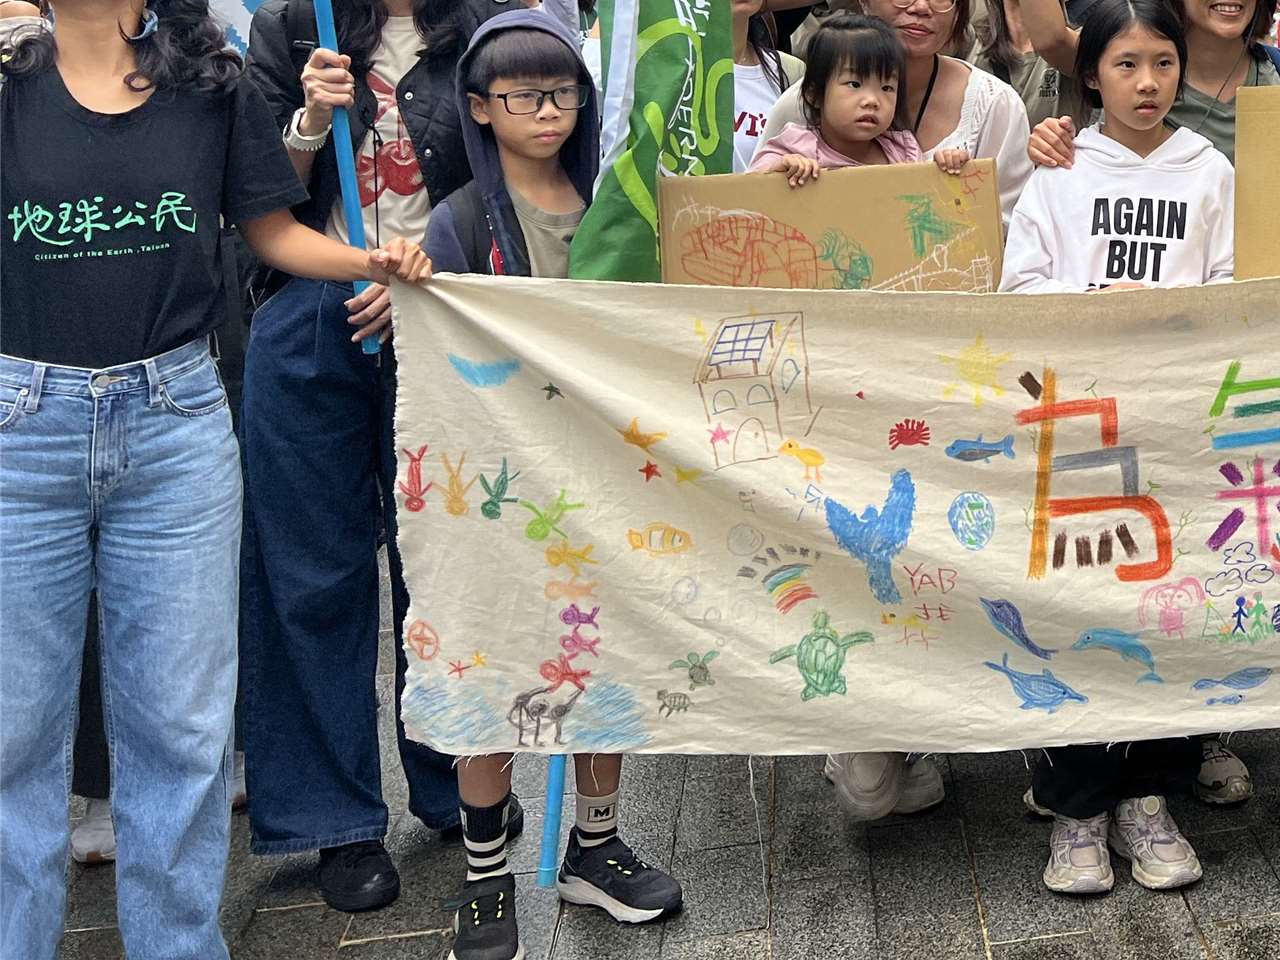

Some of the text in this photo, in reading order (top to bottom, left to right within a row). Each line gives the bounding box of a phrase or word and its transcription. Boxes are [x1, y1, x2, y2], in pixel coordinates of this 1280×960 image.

[7, 191, 198, 246] 地球公民
[1091, 197, 1188, 240] AGAIN
[34, 252, 70, 261] Citizen
[73, 251, 83, 259] of
[107, 248, 134, 256] Earth
[1105, 239, 1167, 282] BUT
